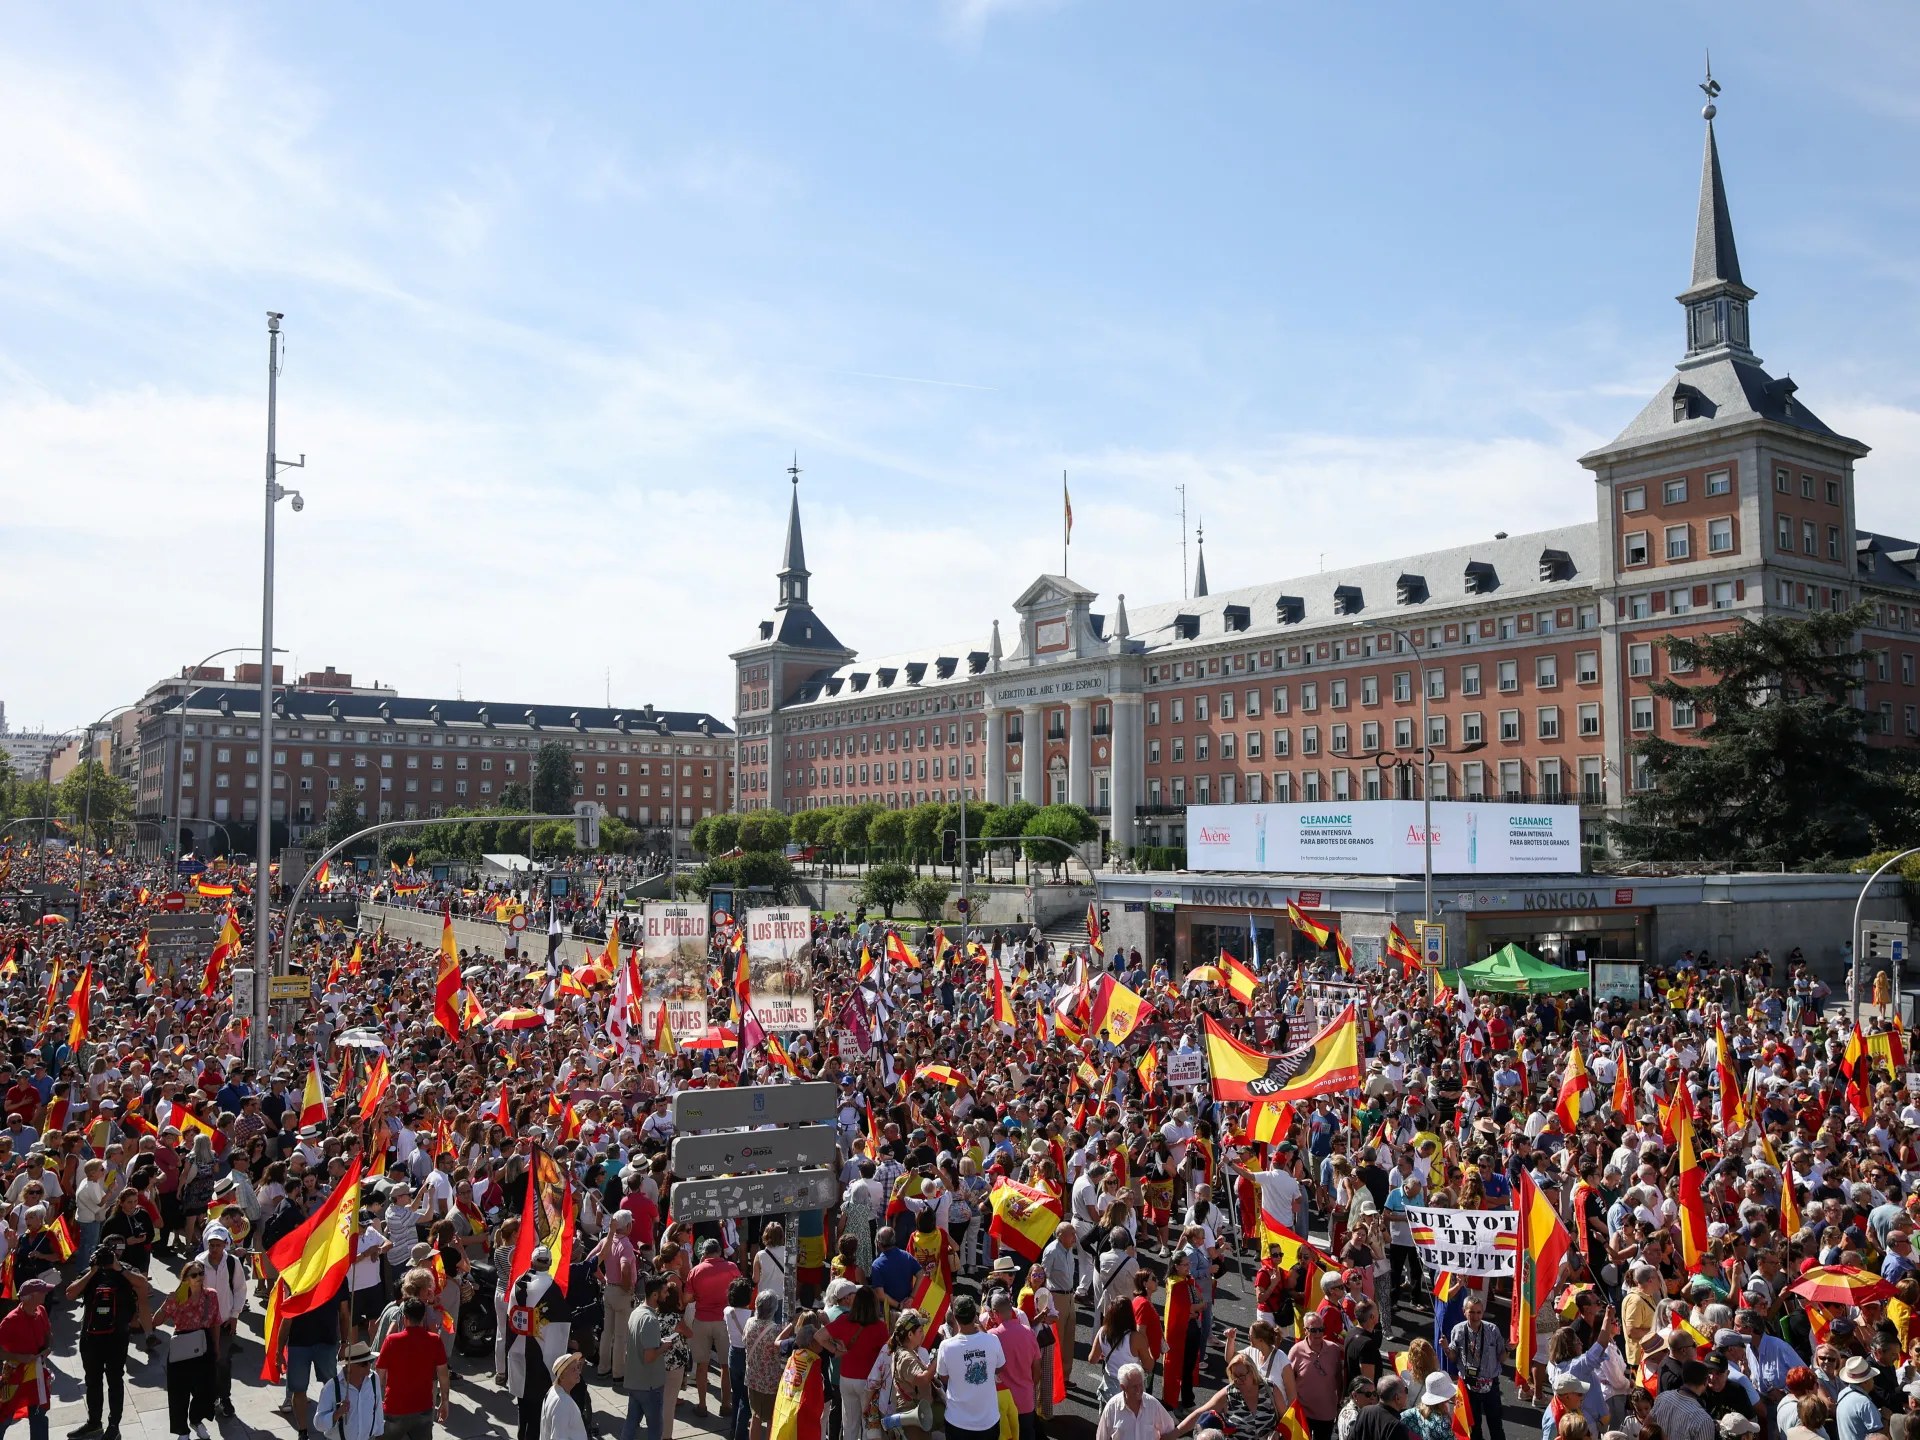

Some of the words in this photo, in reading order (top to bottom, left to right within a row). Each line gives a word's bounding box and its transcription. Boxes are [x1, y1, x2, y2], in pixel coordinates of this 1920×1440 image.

[1026, 687, 1038, 697] DEL
[1040, 684, 1053, 694] AIRE
[1055, 683, 1060, 692] Y
[1062, 681, 1074, 691] DEL
[1076, 677, 1102, 689] ESPACIO
[1300, 815, 1352, 825] CLEANANCE
[1509, 816, 1553, 826] CLEANANCE
[1200, 827, 1231, 842] Avène
[1192, 888, 1273, 908] MONCLOA
[1523, 891, 1598, 911] MONCLOA
[666, 908, 687, 917] CUANDO
[767, 912, 790, 921] CUANDO
[649, 918, 660, 936] EL
[664, 918, 704, 936] PUEBLO
[753, 923, 772, 940] LOS
[774, 921, 806, 938] REYES
[648, 1011, 702, 1030] CONES
[758, 1007, 808, 1023] COJONES
[1406, 1210, 1453, 1228] QUE
[1444, 1229, 1477, 1245] TE
